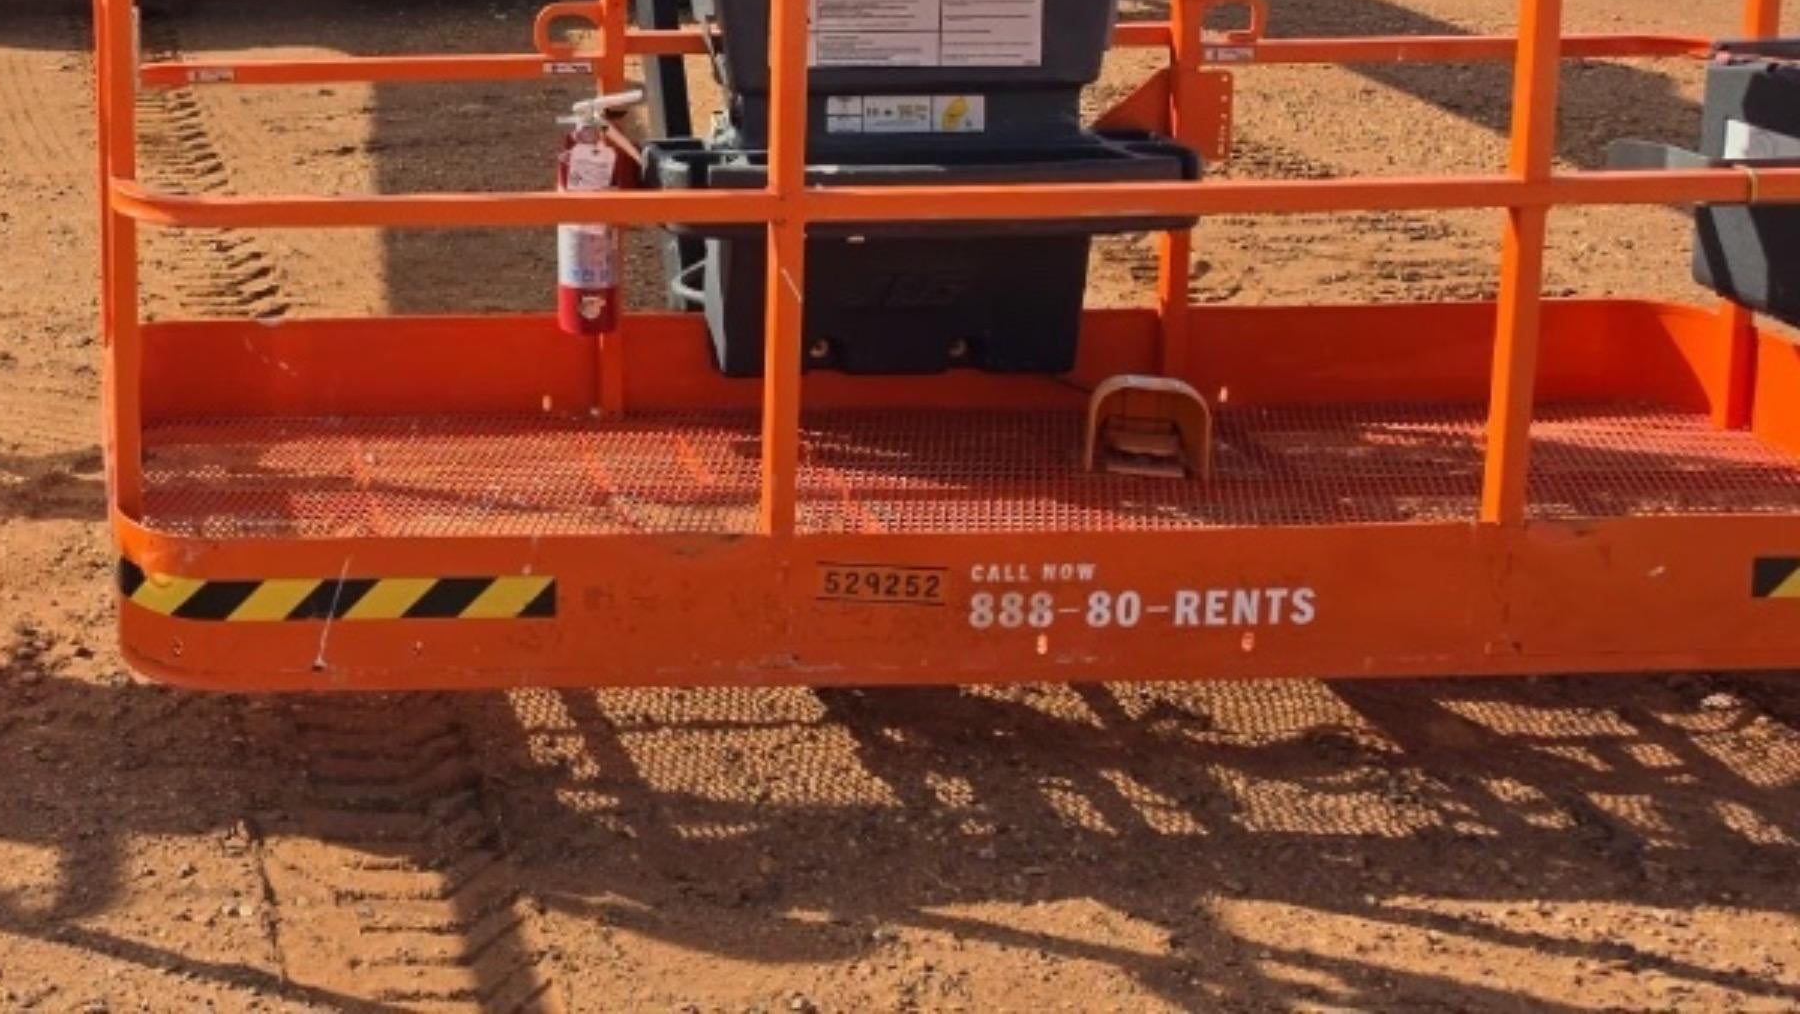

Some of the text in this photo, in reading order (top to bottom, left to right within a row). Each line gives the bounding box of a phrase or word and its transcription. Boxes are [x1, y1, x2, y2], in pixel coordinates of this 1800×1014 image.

[823, 569, 941, 599] 529252
[971, 562, 1095, 582] CALL NOW
[968, 587, 1317, 628] 888-80-RENTS
